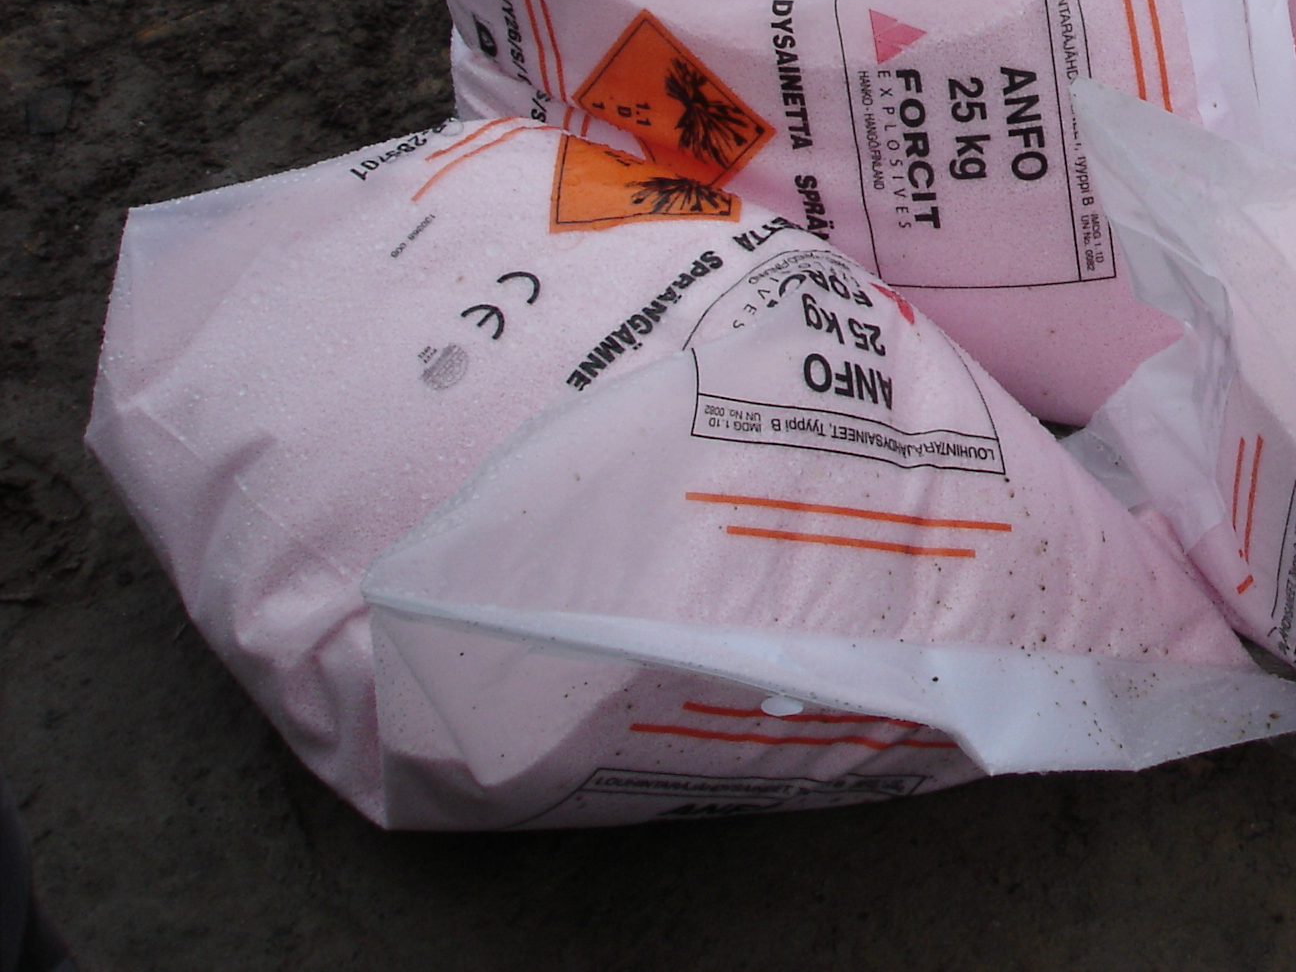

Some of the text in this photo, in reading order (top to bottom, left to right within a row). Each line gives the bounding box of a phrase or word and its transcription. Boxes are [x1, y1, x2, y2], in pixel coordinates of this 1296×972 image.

[616, 105, 633, 117] D
[948, 77, 990, 181] 25 kg
[1000, 66, 1048, 182] ANFO
[878, 70, 910, 229] EXPLOSIVES
[895, 69, 941, 229] FORCIT
[1082, 196, 1094, 206] B
[1080, 214, 1091, 230] UN
[566, 250, 724, 392] SPRÄNGÄMNE
[801, 293, 886, 356] 25 kg
[803, 353, 893, 410] ANFO
[733, 421, 762, 433] IMDG
[745, 411, 761, 421] UN
[770, 418, 781, 432] B
[785, 418, 825, 437] Tyyppi
